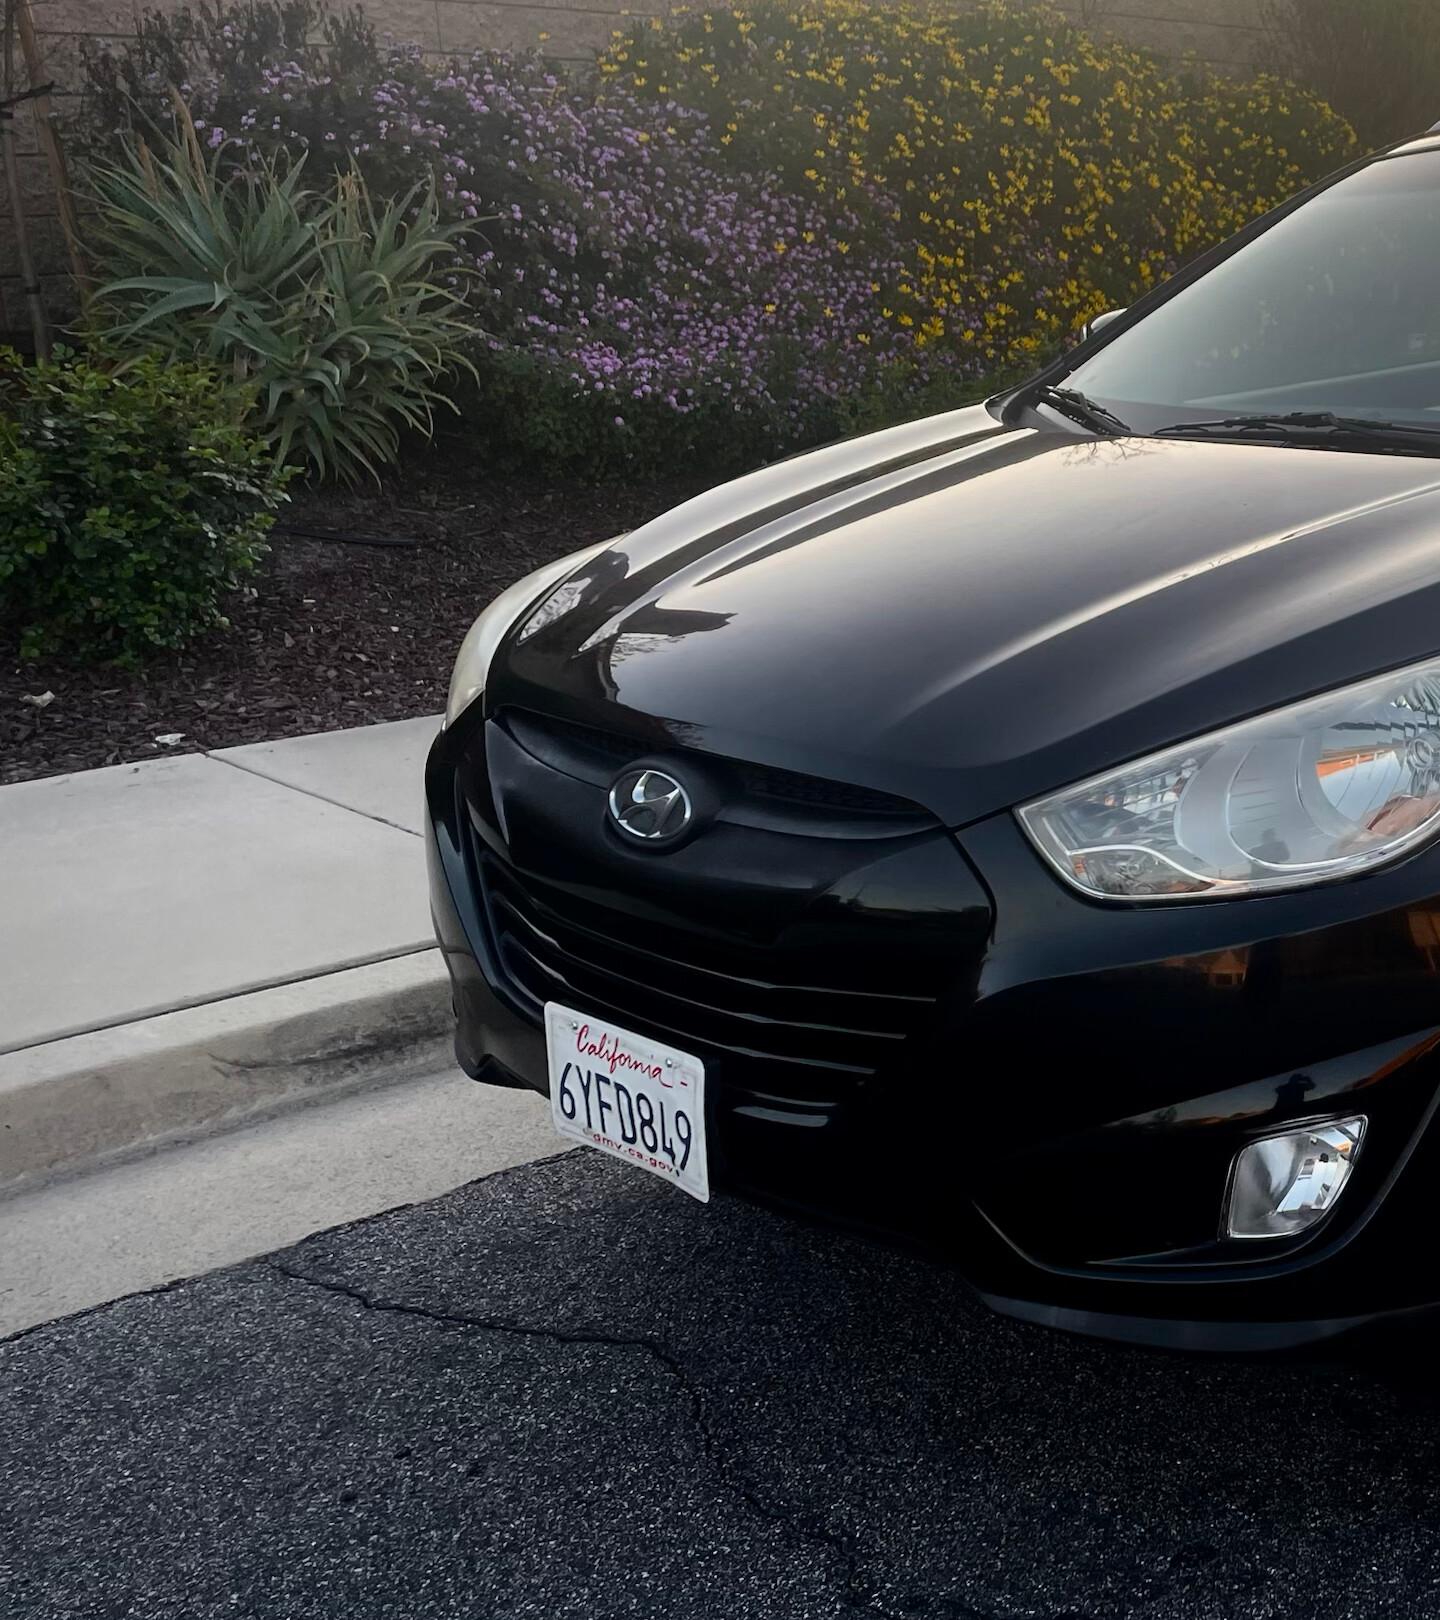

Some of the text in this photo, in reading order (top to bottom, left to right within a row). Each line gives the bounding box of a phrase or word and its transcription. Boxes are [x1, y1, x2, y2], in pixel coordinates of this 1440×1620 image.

[576, 1024, 673, 1088] California
[559, 1062, 692, 1177] 6YFD849
[592, 1133, 674, 1173] dmv.ca.gov
